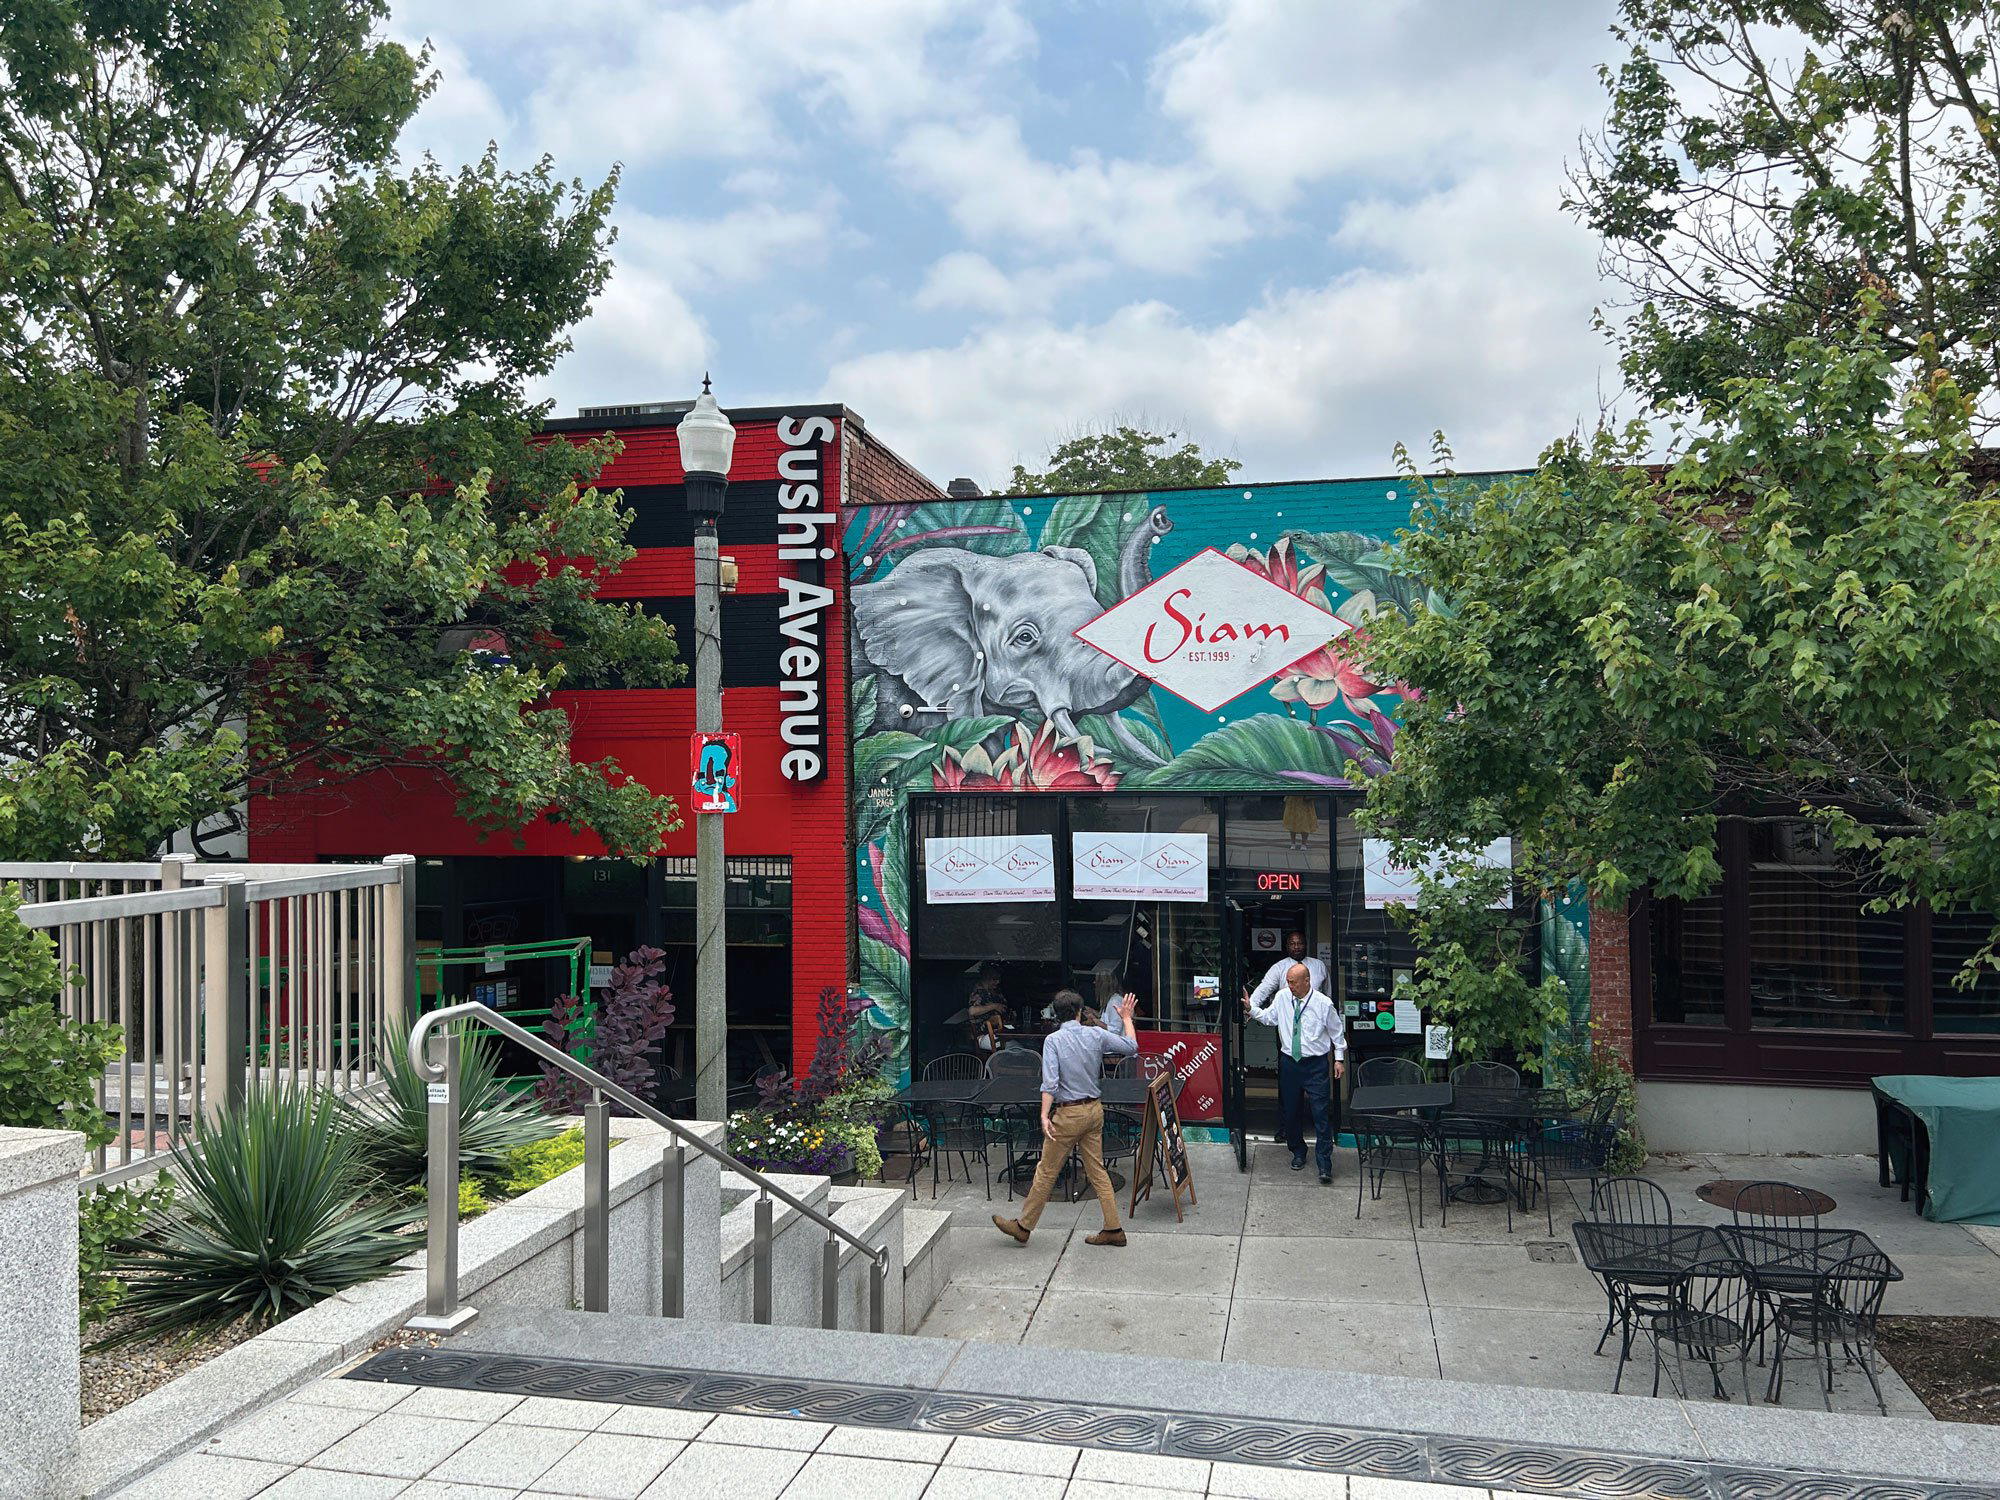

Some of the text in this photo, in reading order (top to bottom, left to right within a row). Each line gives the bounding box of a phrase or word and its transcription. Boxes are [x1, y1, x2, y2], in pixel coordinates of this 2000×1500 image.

[777, 414, 837, 782] Sushi Avenue
[1144, 588, 1290, 663] Siam
[867, 787, 895, 798] JANICE
[945, 854, 976, 873] Siam
[1007, 853, 1039, 871] Siam
[1091, 850, 1124, 868] Siam
[1156, 851, 1190, 869] Siam
[594, 869, 611, 881] 131
[1257, 874, 1300, 890] OPEN
[1144, 1040, 1187, 1080] Siam
[1199, 1097, 1214, 1111] 1999
